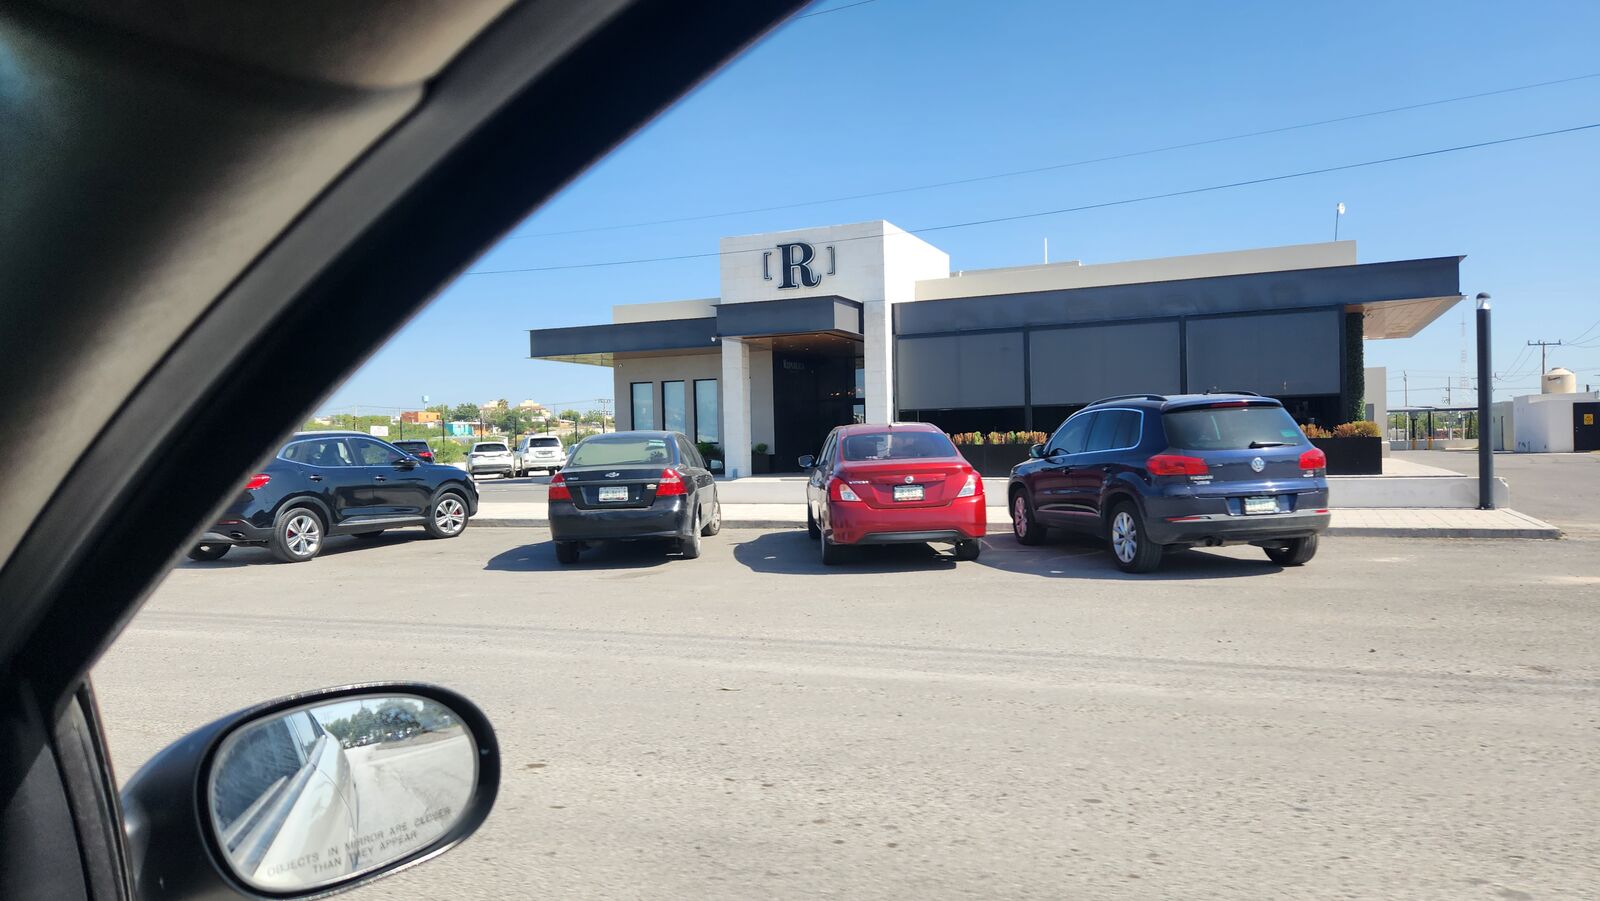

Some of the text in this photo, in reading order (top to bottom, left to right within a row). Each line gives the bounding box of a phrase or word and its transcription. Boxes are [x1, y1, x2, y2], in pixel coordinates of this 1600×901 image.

[266, 852, 320, 877] OBJECTS
[328, 846, 339, 857] IN
[344, 830, 384, 851] MIRROR
[389, 822, 408, 836] ARE
[312, 857, 342, 874] THAN
[380, 830, 418, 850] APPEAR
